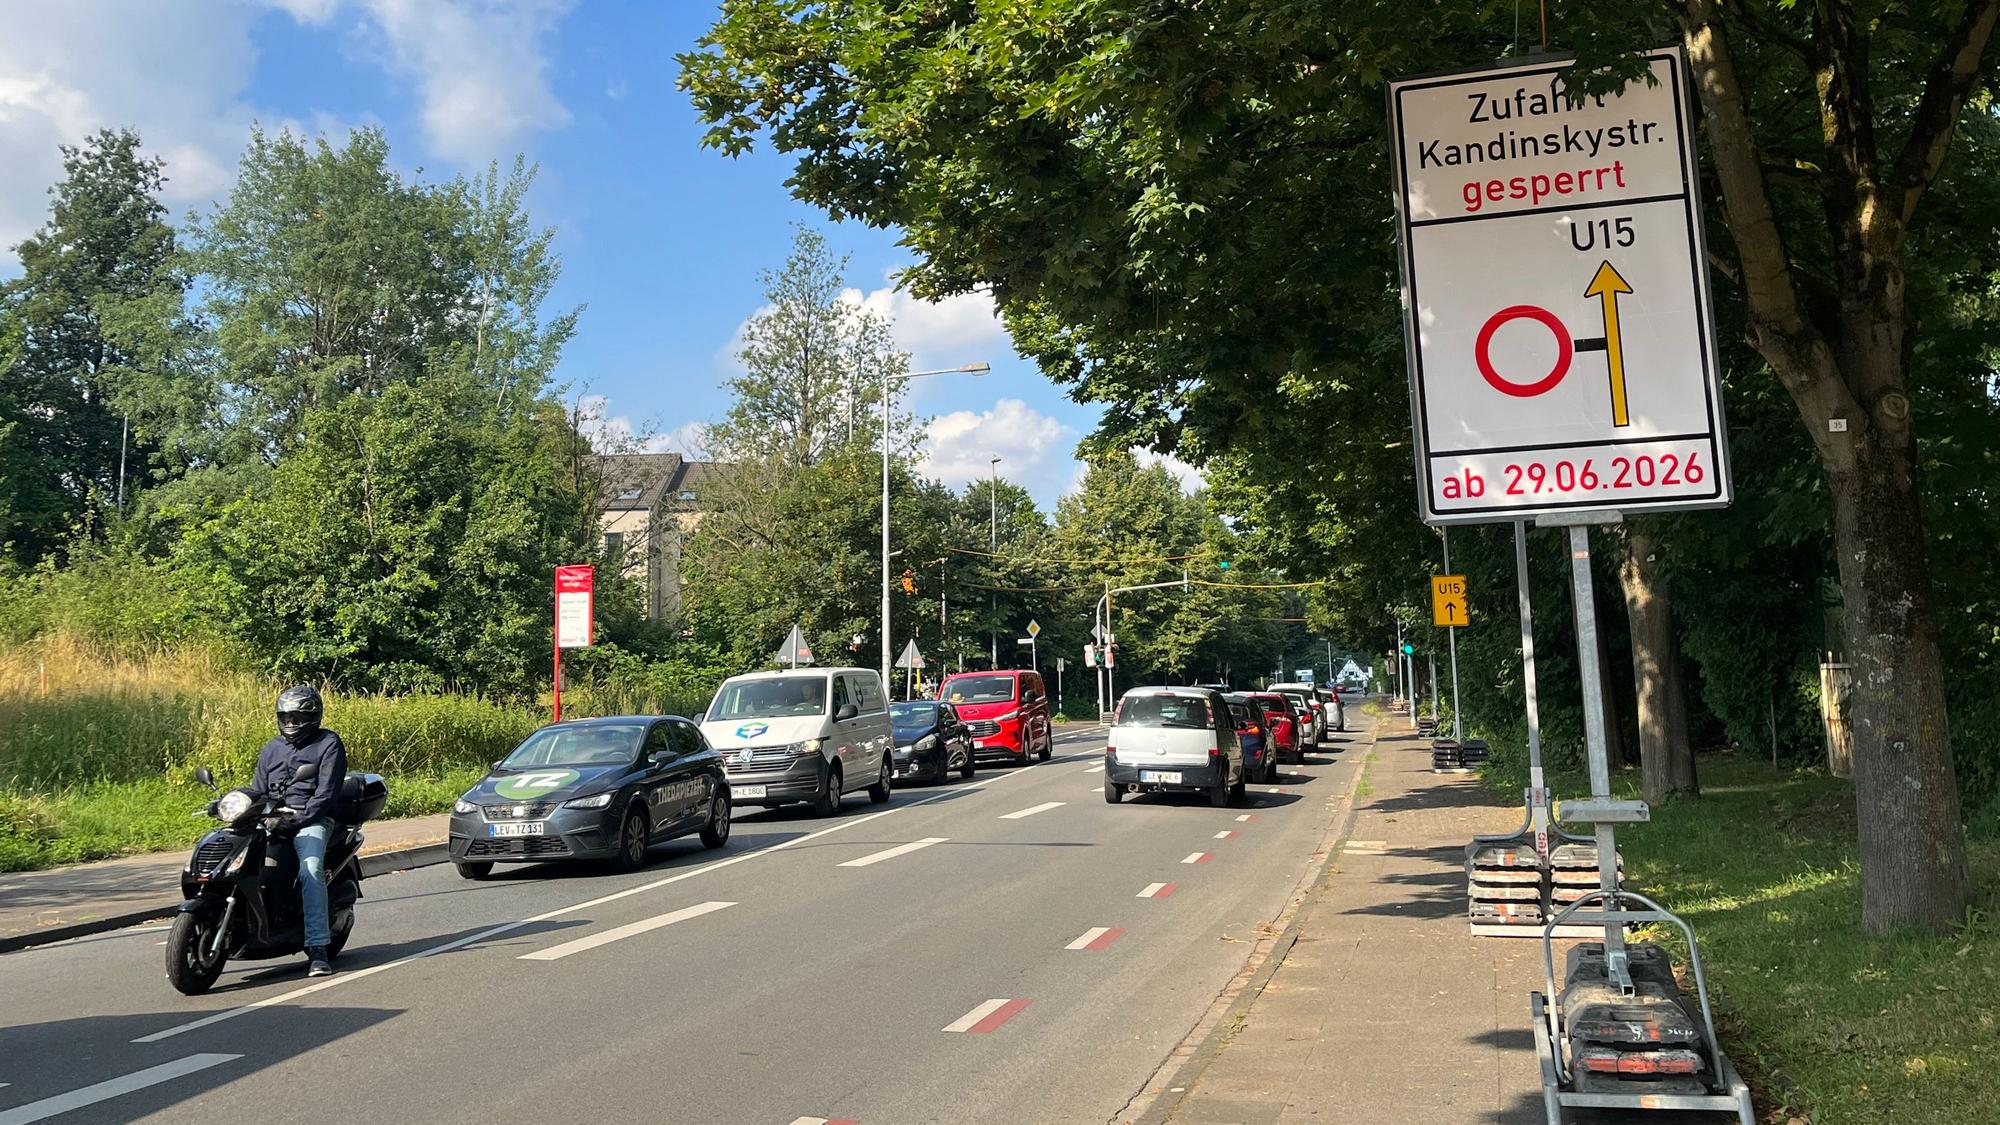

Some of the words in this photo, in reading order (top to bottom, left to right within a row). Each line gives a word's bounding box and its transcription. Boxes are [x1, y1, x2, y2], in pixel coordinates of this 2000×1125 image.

[1419, 119, 1664, 168] Kandinskystr.
[1462, 160, 1626, 211] gesperrt
[1570, 217, 1635, 251] U15
[1442, 467, 1485, 499] ab
[1504, 452, 1704, 495] 29.06.2026
[1438, 583, 1460, 594] U15
[513, 773, 570, 788] TZ
[748, 787, 765, 795] 1800
[495, 825, 510, 835] LEV
[516, 825, 526, 834] TZ
[527, 824, 543, 834] 131
